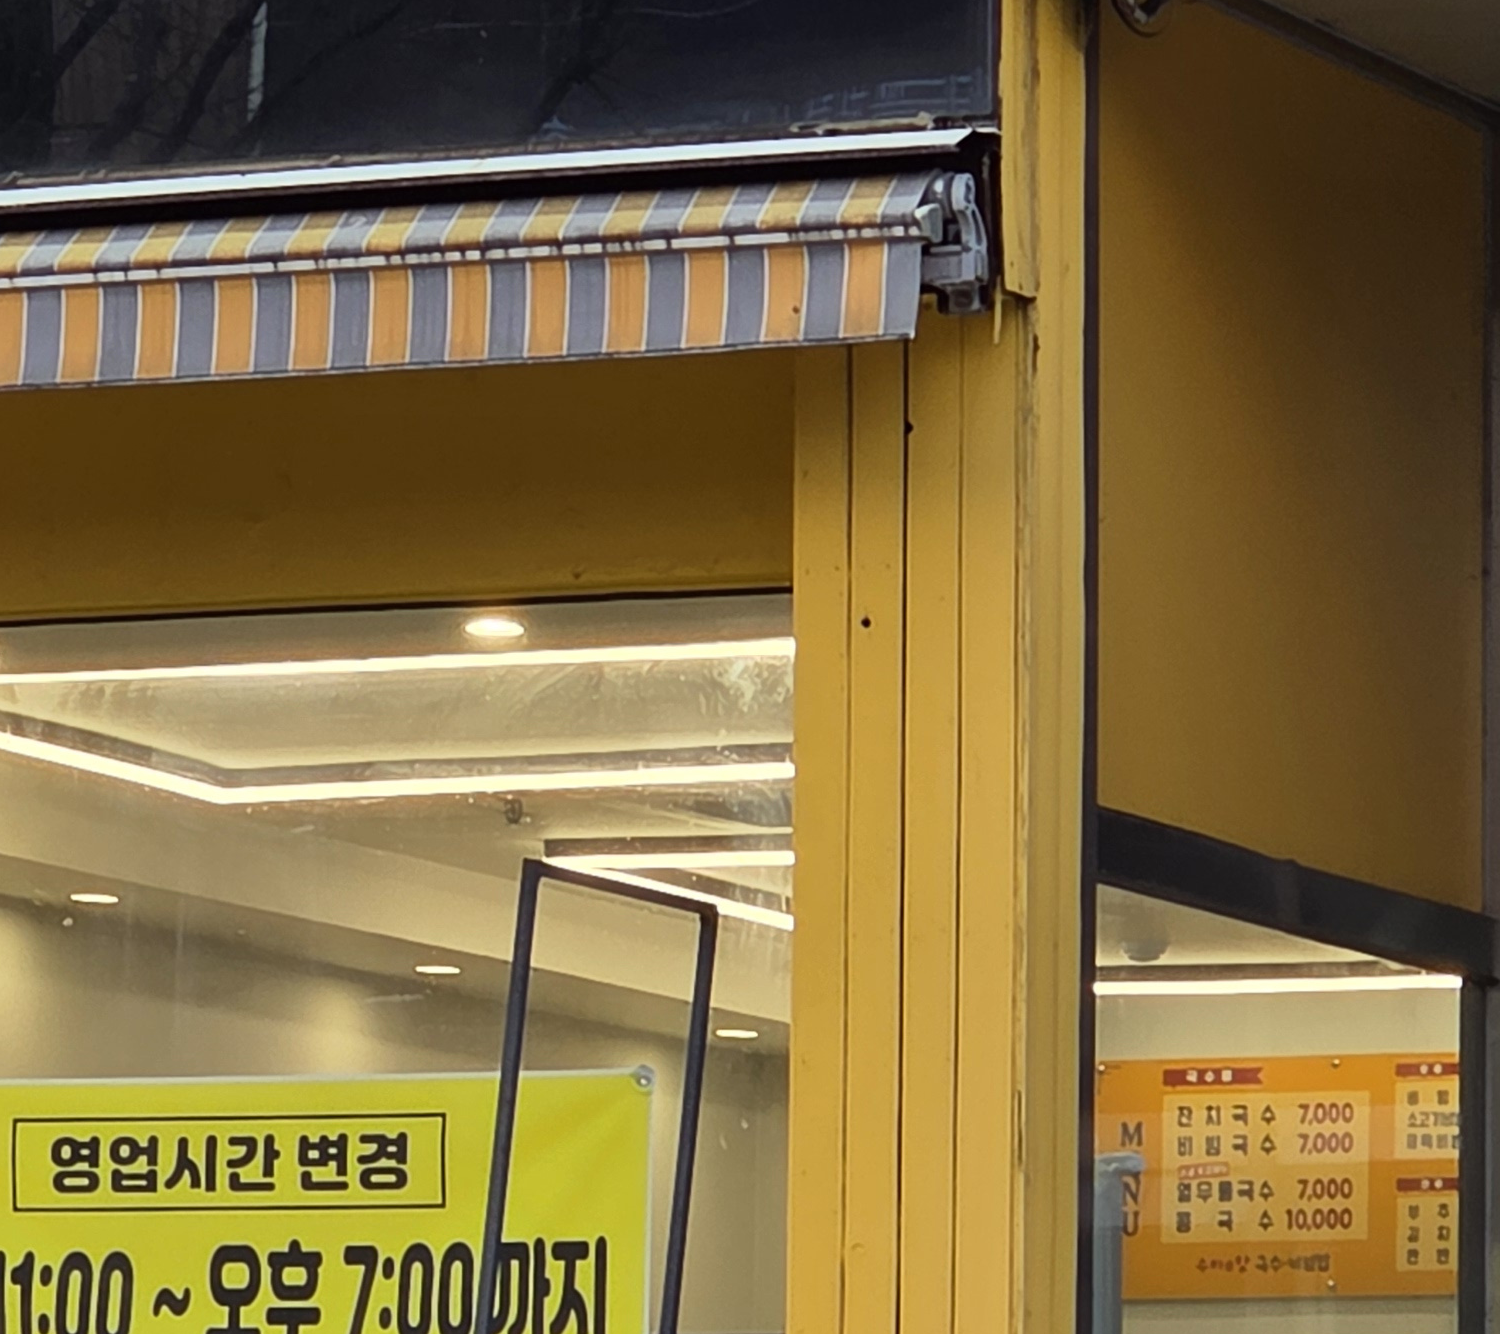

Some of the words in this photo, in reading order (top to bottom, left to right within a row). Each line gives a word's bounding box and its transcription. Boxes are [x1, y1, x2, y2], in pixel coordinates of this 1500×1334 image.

[1297, 1102, 1354, 1126] 7,000
[1297, 1132, 1354, 1156] 7,000
[51, 1134, 281, 1193] 영업시간
[298, 1132, 409, 1192] 변경
[1120, 1121, 1143, 1237] MNU
[1296, 1177, 1353, 1202] 7,000
[1286, 1208, 1353, 1232] 10,000
